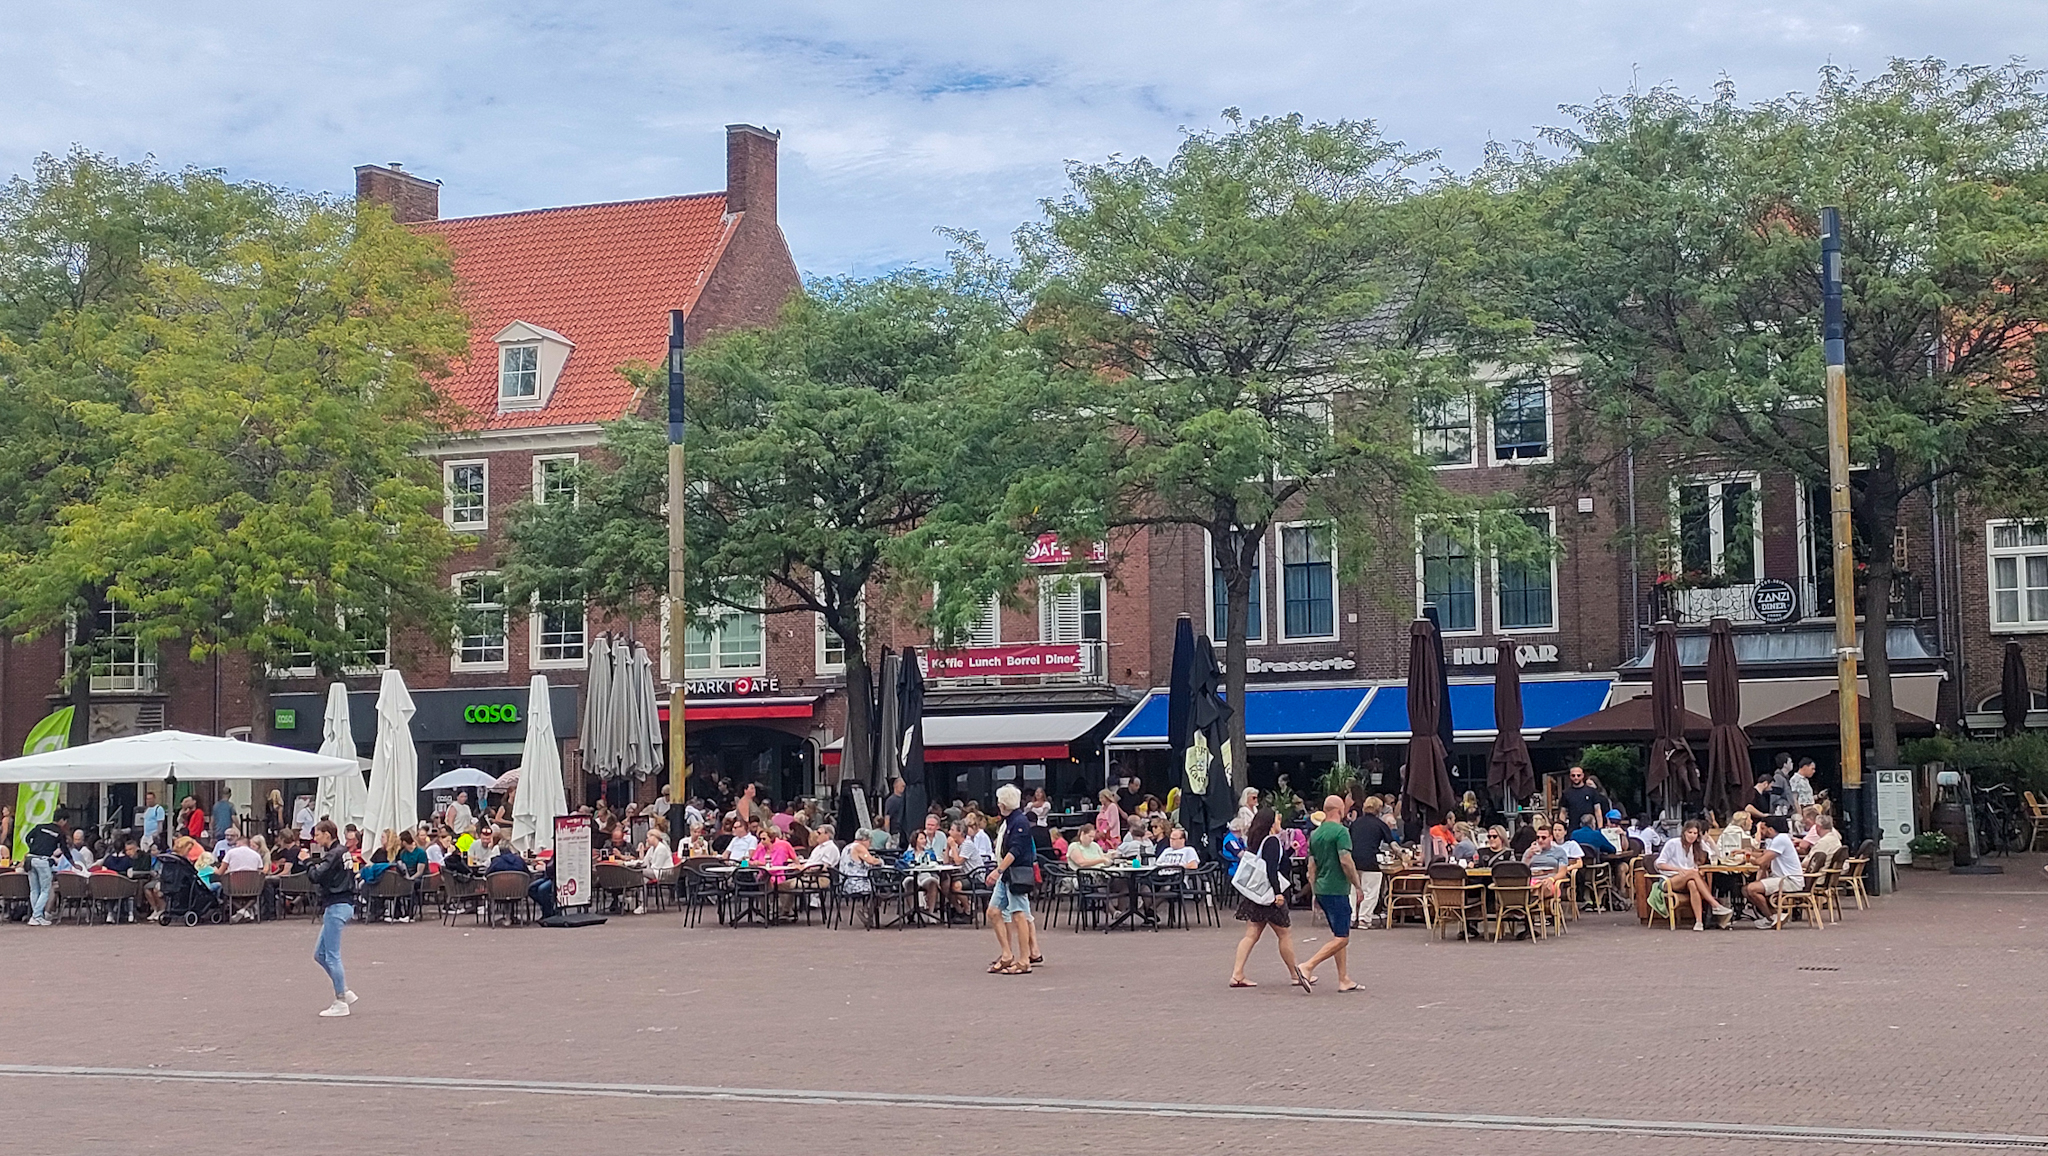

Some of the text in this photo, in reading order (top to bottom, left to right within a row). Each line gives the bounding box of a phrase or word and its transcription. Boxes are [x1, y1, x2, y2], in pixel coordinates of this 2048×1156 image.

[1757, 591, 1790, 603] ZANZI
[1761, 602, 1787, 611] DINER
[931, 653, 1076, 669] Koffie Lunch Borrel Diner
[1246, 657, 1357, 674] Brasserie
[277, 715, 294, 723] casa
[463, 703, 518, 724] casa
